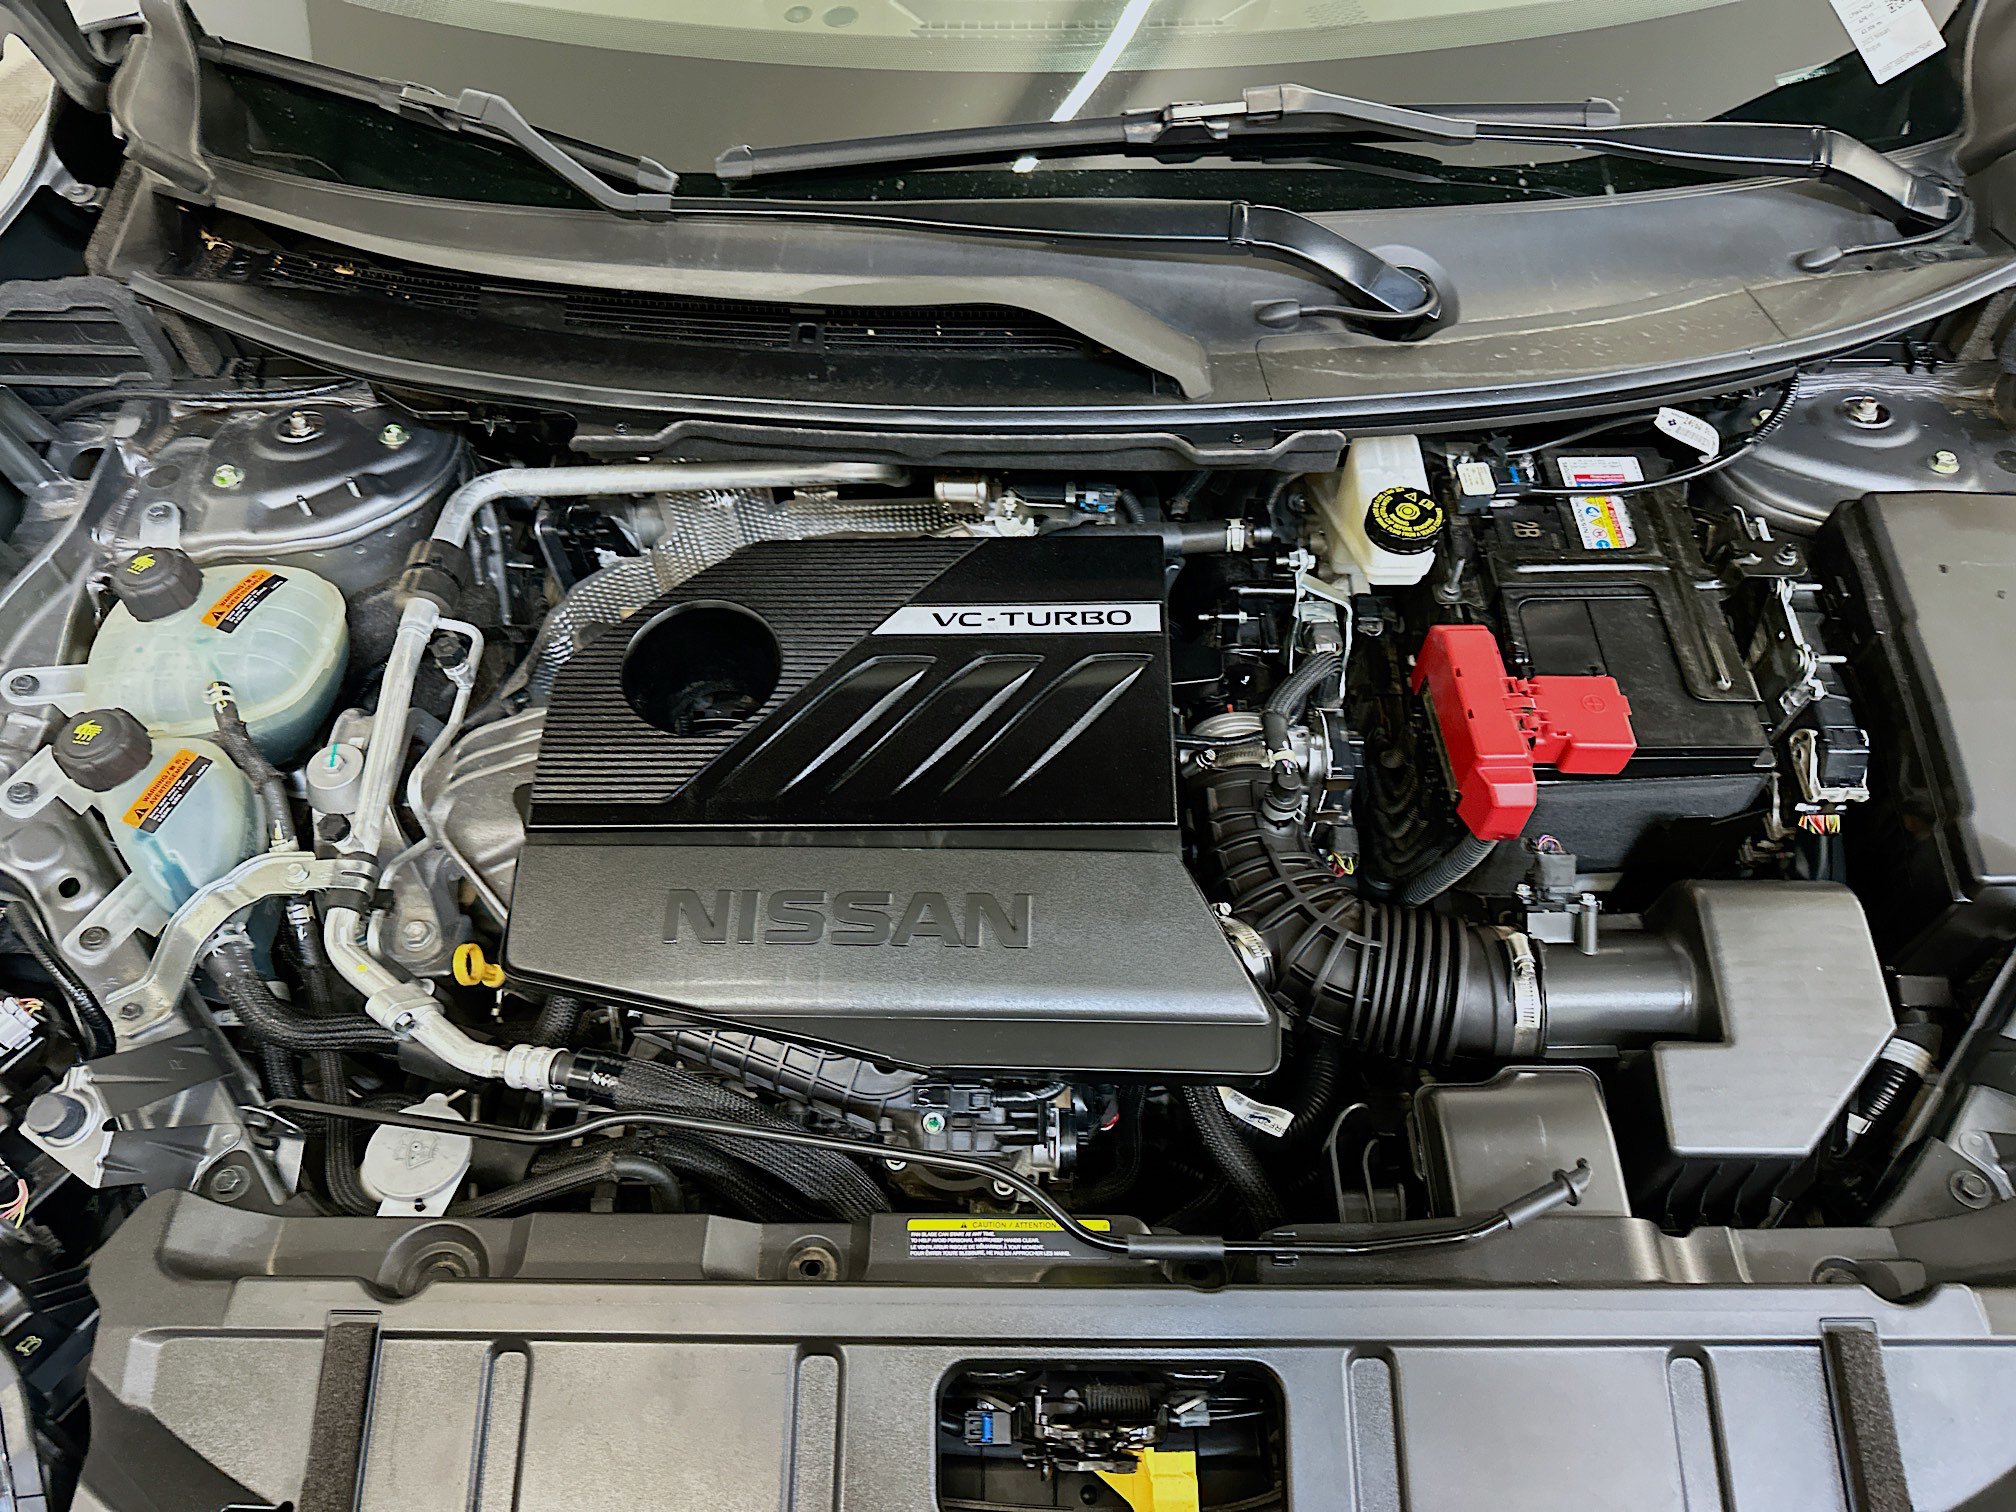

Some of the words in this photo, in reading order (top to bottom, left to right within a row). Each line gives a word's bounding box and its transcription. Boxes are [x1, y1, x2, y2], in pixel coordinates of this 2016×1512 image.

[932, 610, 1132, 627] VC-TURBO
[142, 774, 168, 802] WARNING
[150, 756, 190, 805] AVERTISSEMENT
[662, 889, 1032, 948] NISSAN
